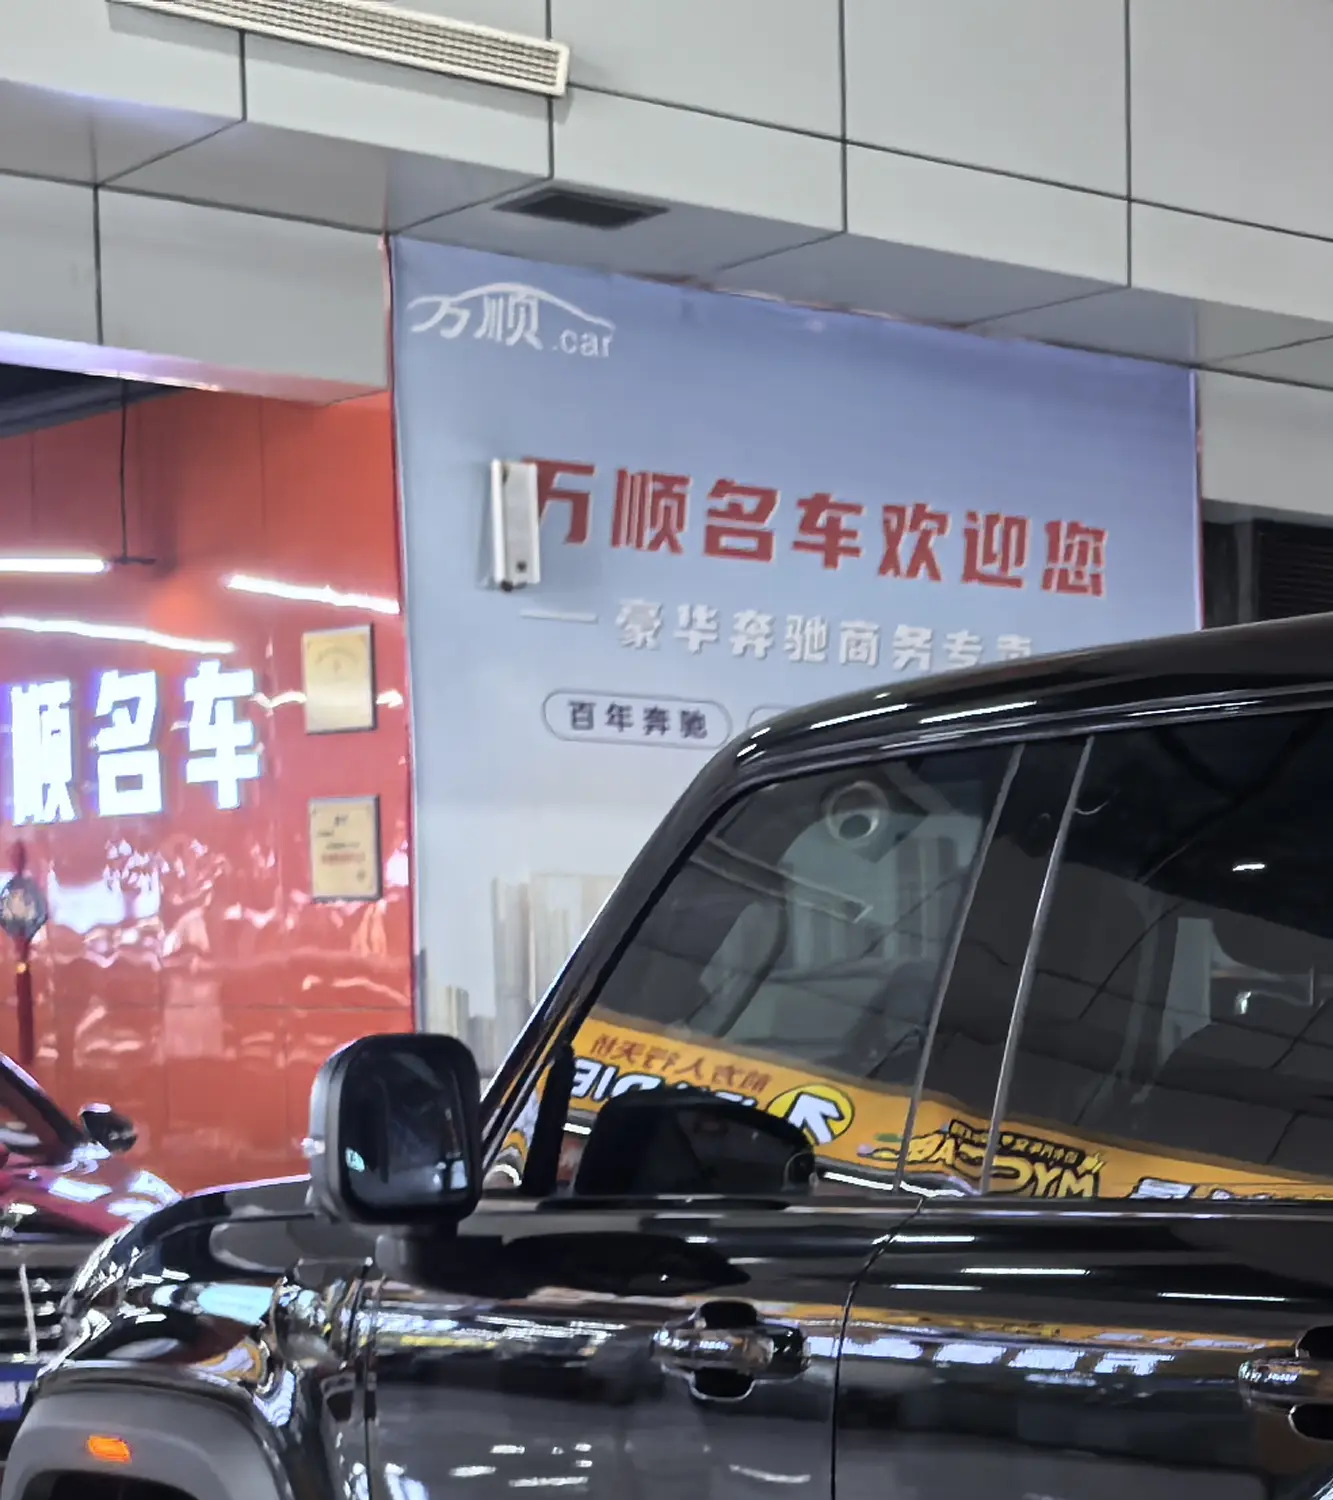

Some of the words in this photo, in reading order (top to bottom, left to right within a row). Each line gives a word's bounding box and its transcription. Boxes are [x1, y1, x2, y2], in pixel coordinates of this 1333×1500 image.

[408, 291, 541, 351] 万顺
[522, 456, 1109, 597] 万顺名车欢迎您
[11, 661, 261, 826] 顺名车
[569, 700, 709, 741] 百年奔驰
